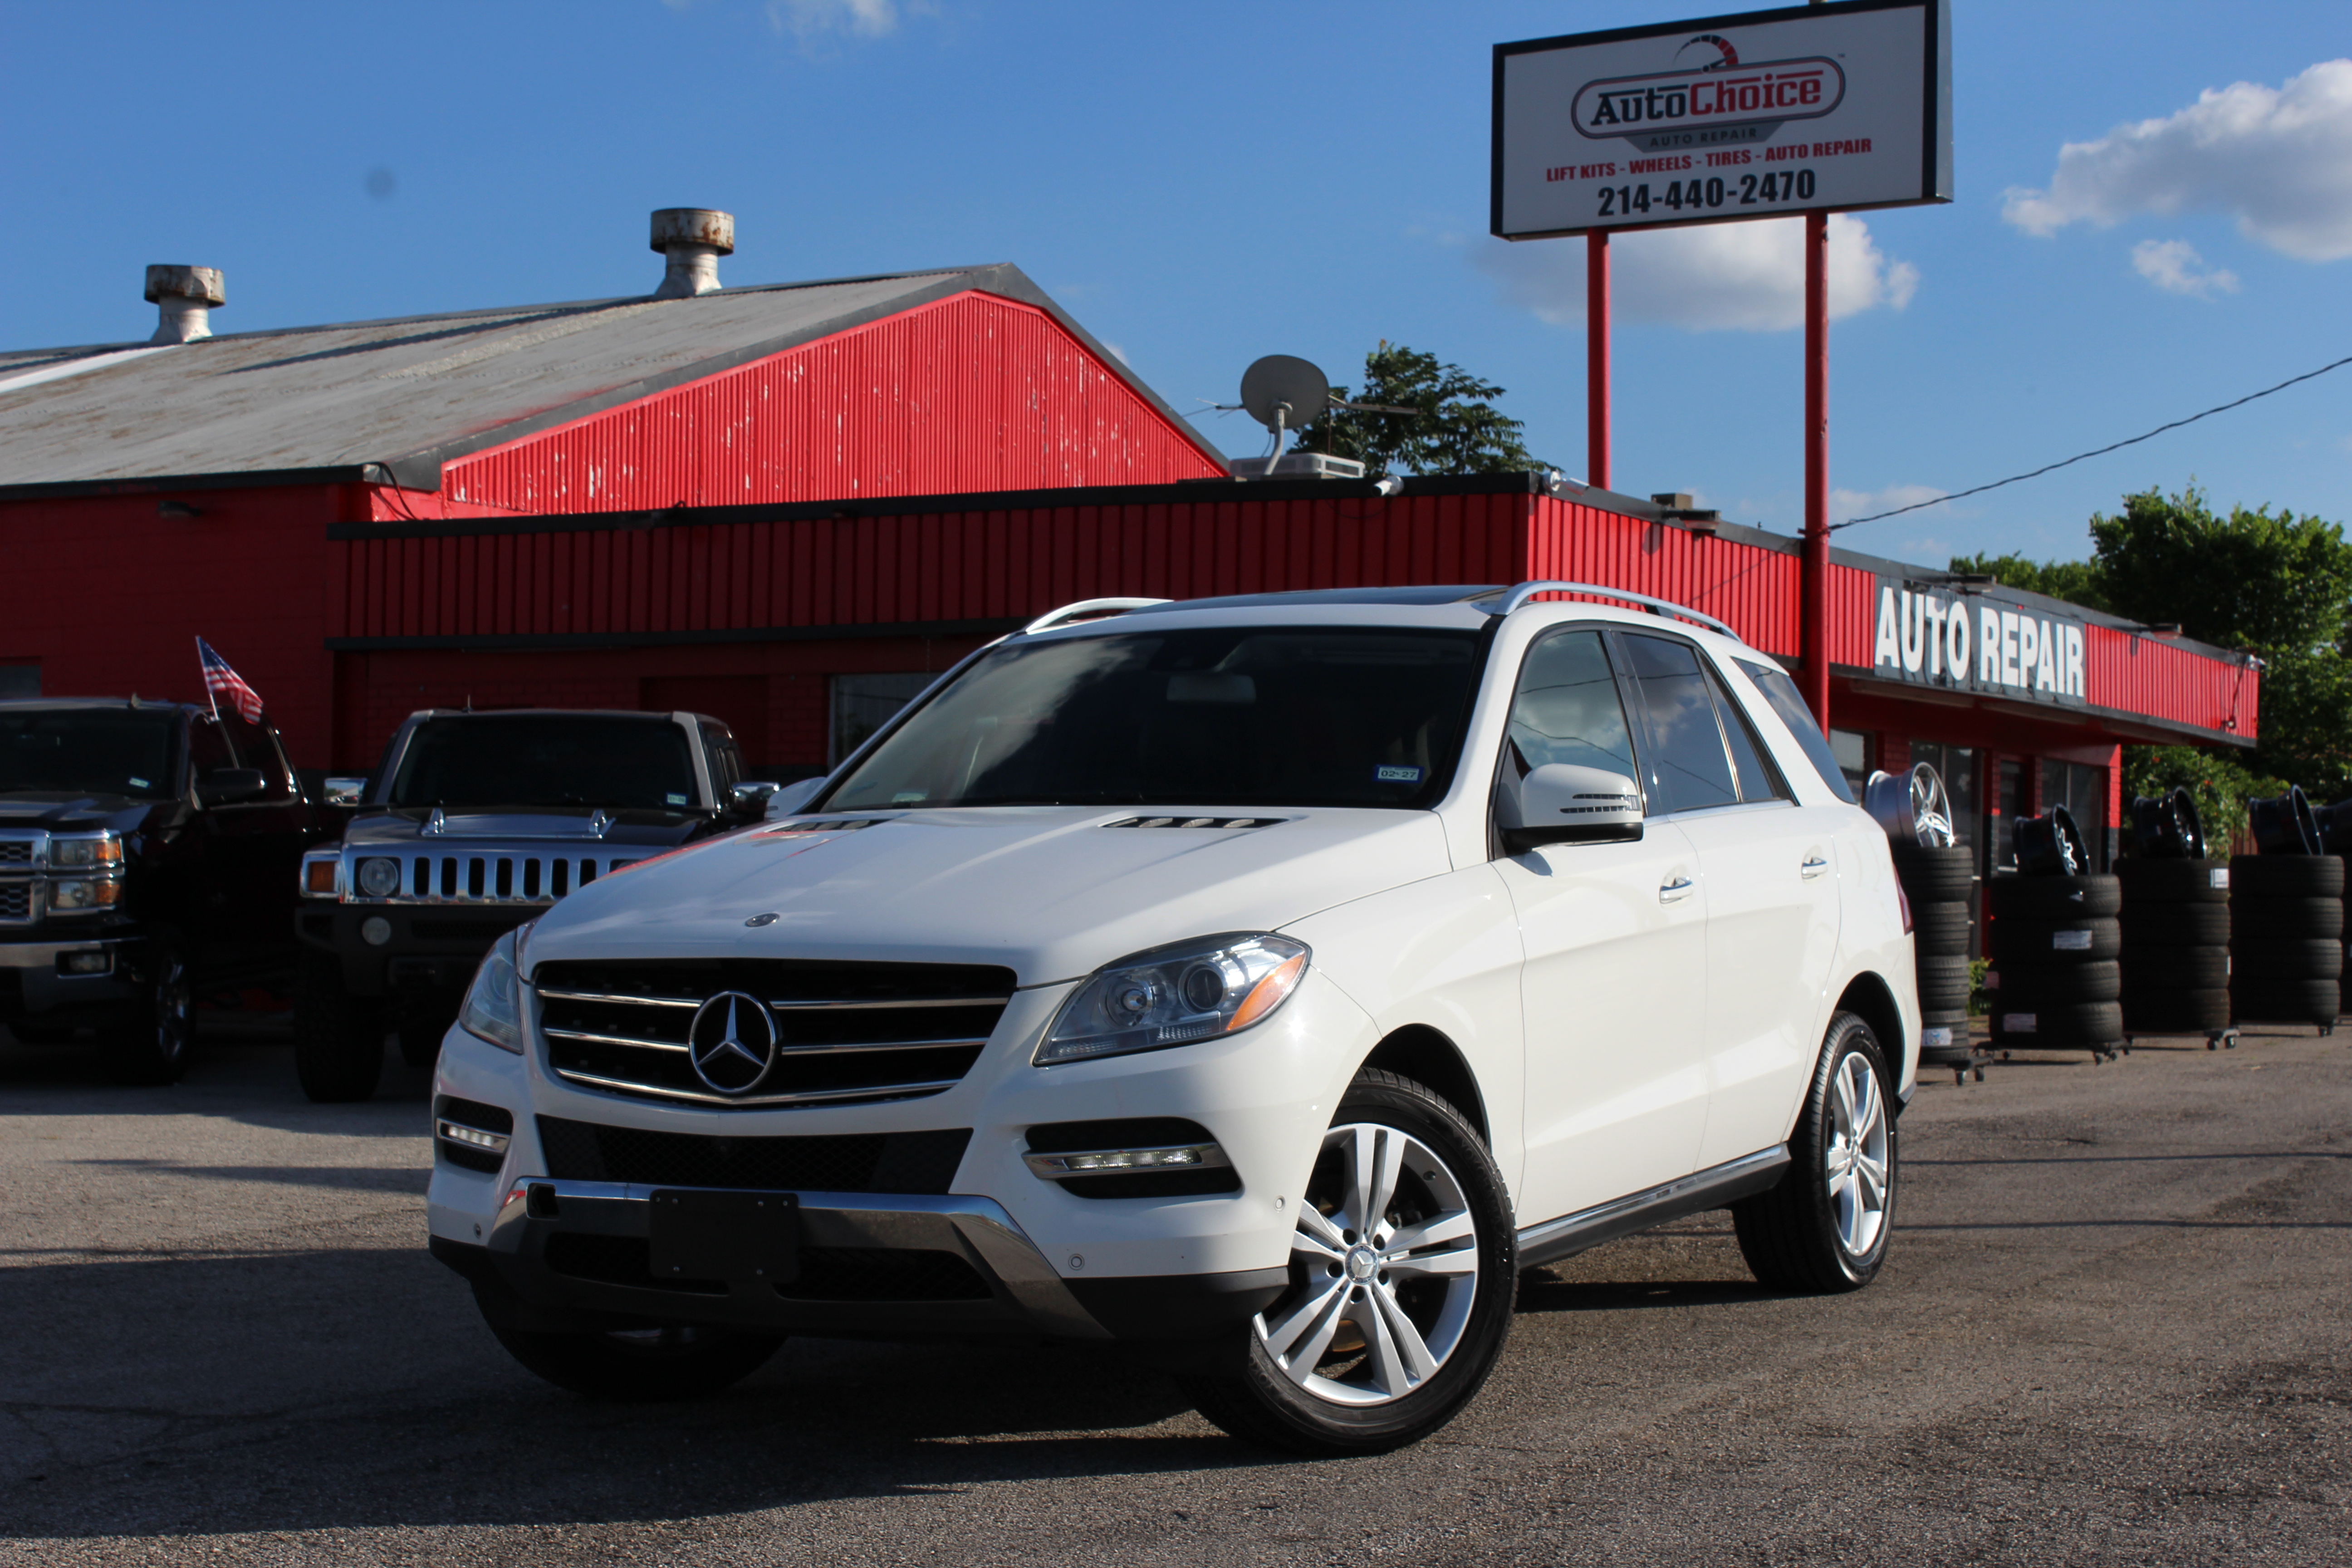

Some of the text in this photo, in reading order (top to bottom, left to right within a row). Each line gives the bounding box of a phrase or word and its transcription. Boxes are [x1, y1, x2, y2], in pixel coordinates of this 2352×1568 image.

[1590, 70, 1823, 126] AutoChoice
[1546, 166, 1577, 182] LIFT
[1580, 162, 1616, 179] KITS
[1628, 155, 1692, 174] WHEELS
[1705, 149, 1752, 167] TIRES
[1765, 144, 1808, 162] AUTO
[1813, 138, 1872, 157] REPAIR
[1650, 128, 1757, 147] AUTO REPAIR
[1597, 168, 1816, 217] 214-440-2470
[1875, 586, 2084, 698] AUTO REPAIR
